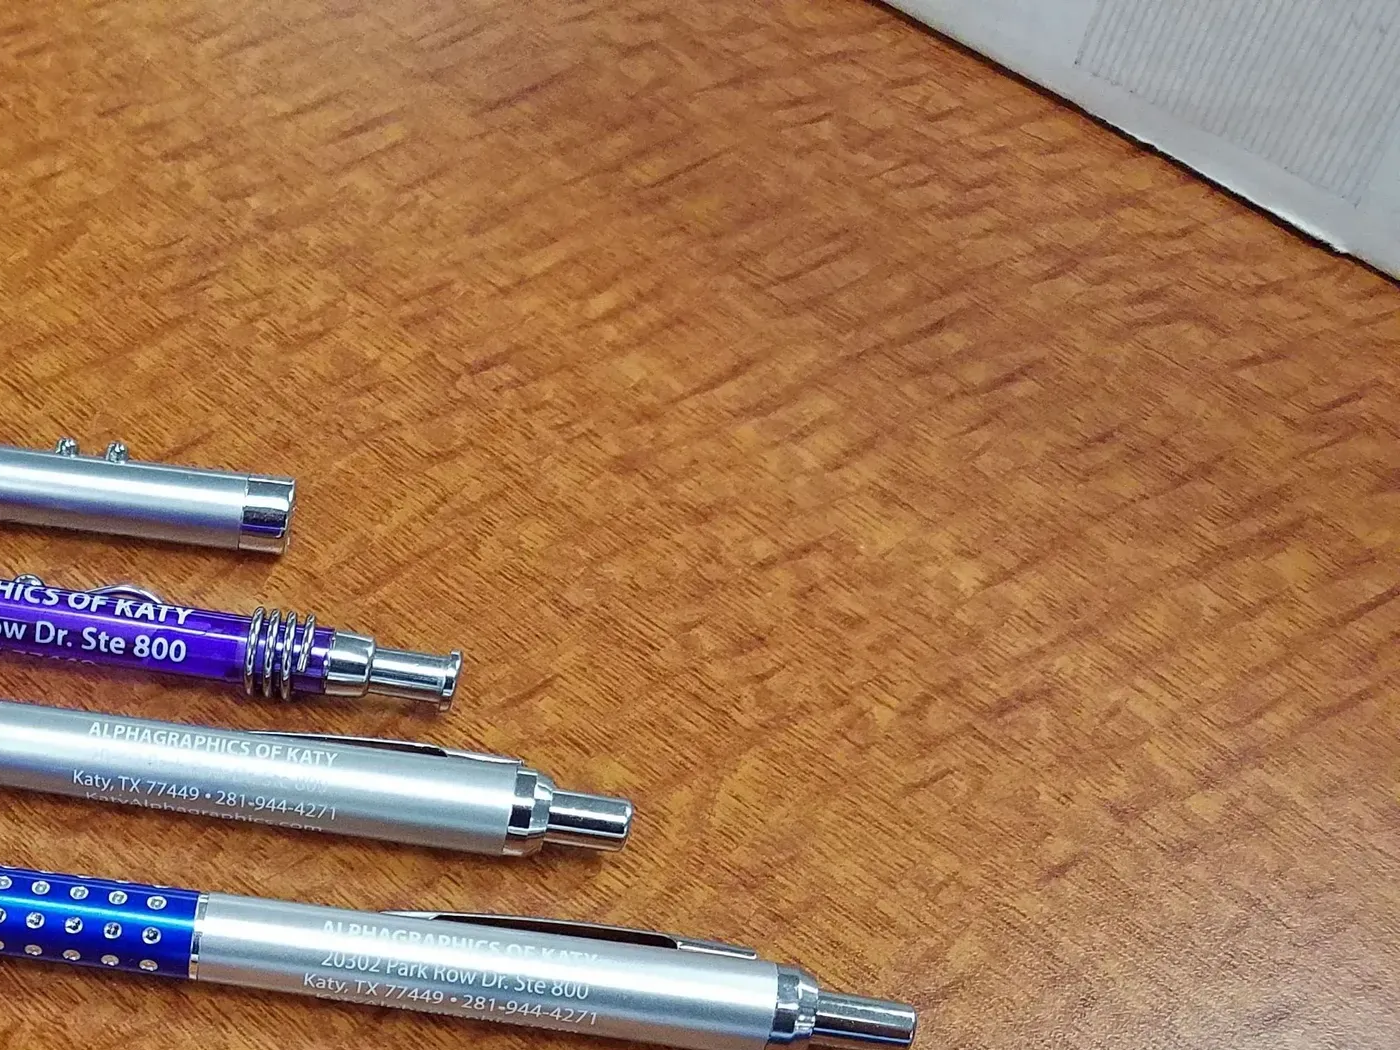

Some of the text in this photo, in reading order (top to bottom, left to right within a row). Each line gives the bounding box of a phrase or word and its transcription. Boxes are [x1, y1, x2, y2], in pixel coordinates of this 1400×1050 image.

[68, 592, 106, 612] OF
[114, 597, 194, 625] KATY
[35, 621, 72, 648] Dr.
[82, 627, 126, 655] Ste
[133, 634, 187, 663] 800
[89, 722, 338, 767] ALPHAGRAPHICS OF KATY
[73, 769, 114, 792] Katy,
[119, 776, 142, 794] TX
[146, 781, 199, 800] 77449
[215, 790, 336, 820] 281-944-4271
[303, 972, 349, 994] Katy,
[354, 979, 379, 996] TX
[384, 984, 444, 1004] 77449
[461, 994, 598, 1025] 281-944-4271
[321, 950, 590, 1000] 20302 Park Row Dr. Ste 800
